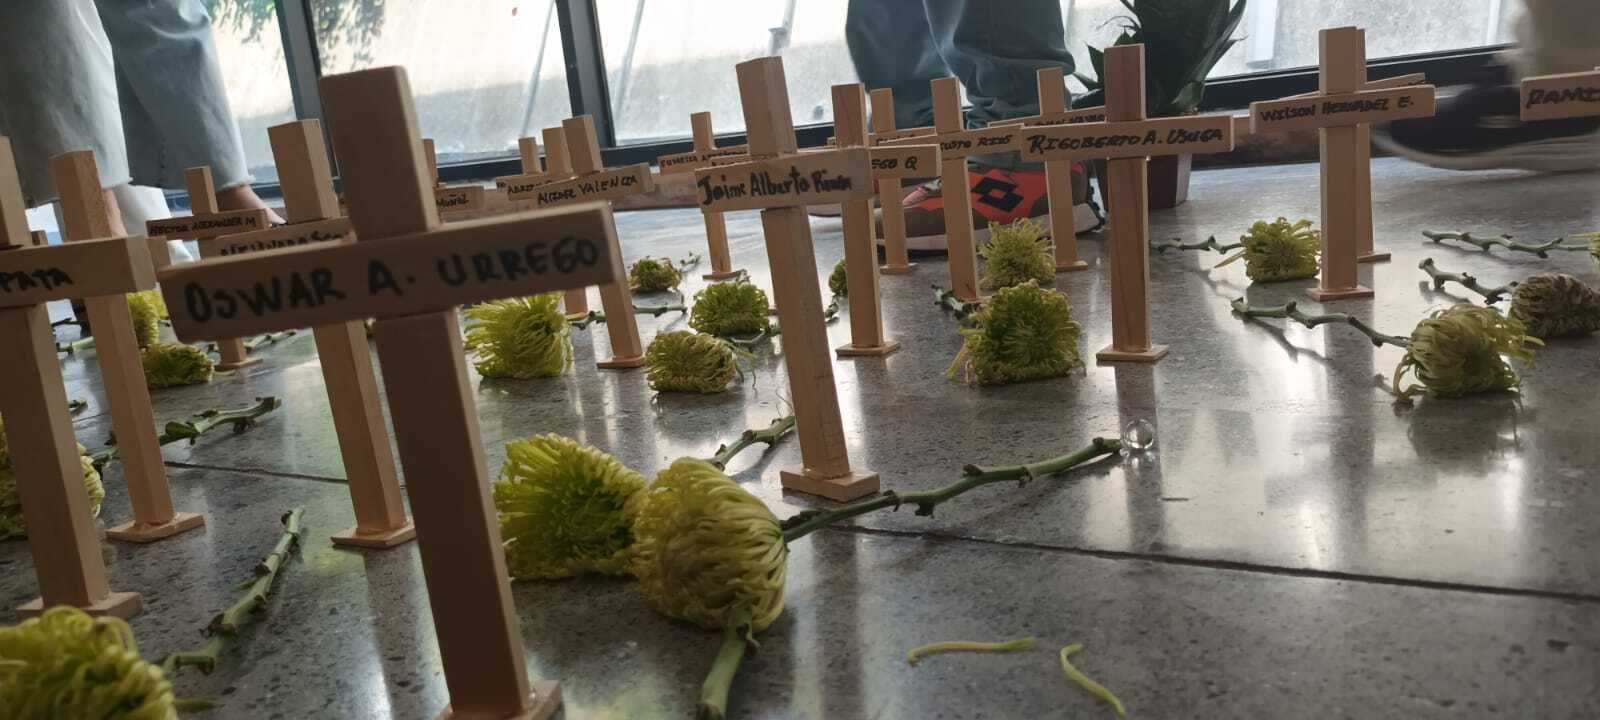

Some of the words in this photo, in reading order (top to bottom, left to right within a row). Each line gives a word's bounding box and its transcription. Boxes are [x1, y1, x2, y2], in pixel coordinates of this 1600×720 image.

[1027, 134, 1140, 154] RIGOBERTO
[697, 174, 747, 206] Jaime
[750, 165, 810, 197] Alberto
[184, 267, 348, 324] OSWAR
[436, 236, 599, 288] URREGO
